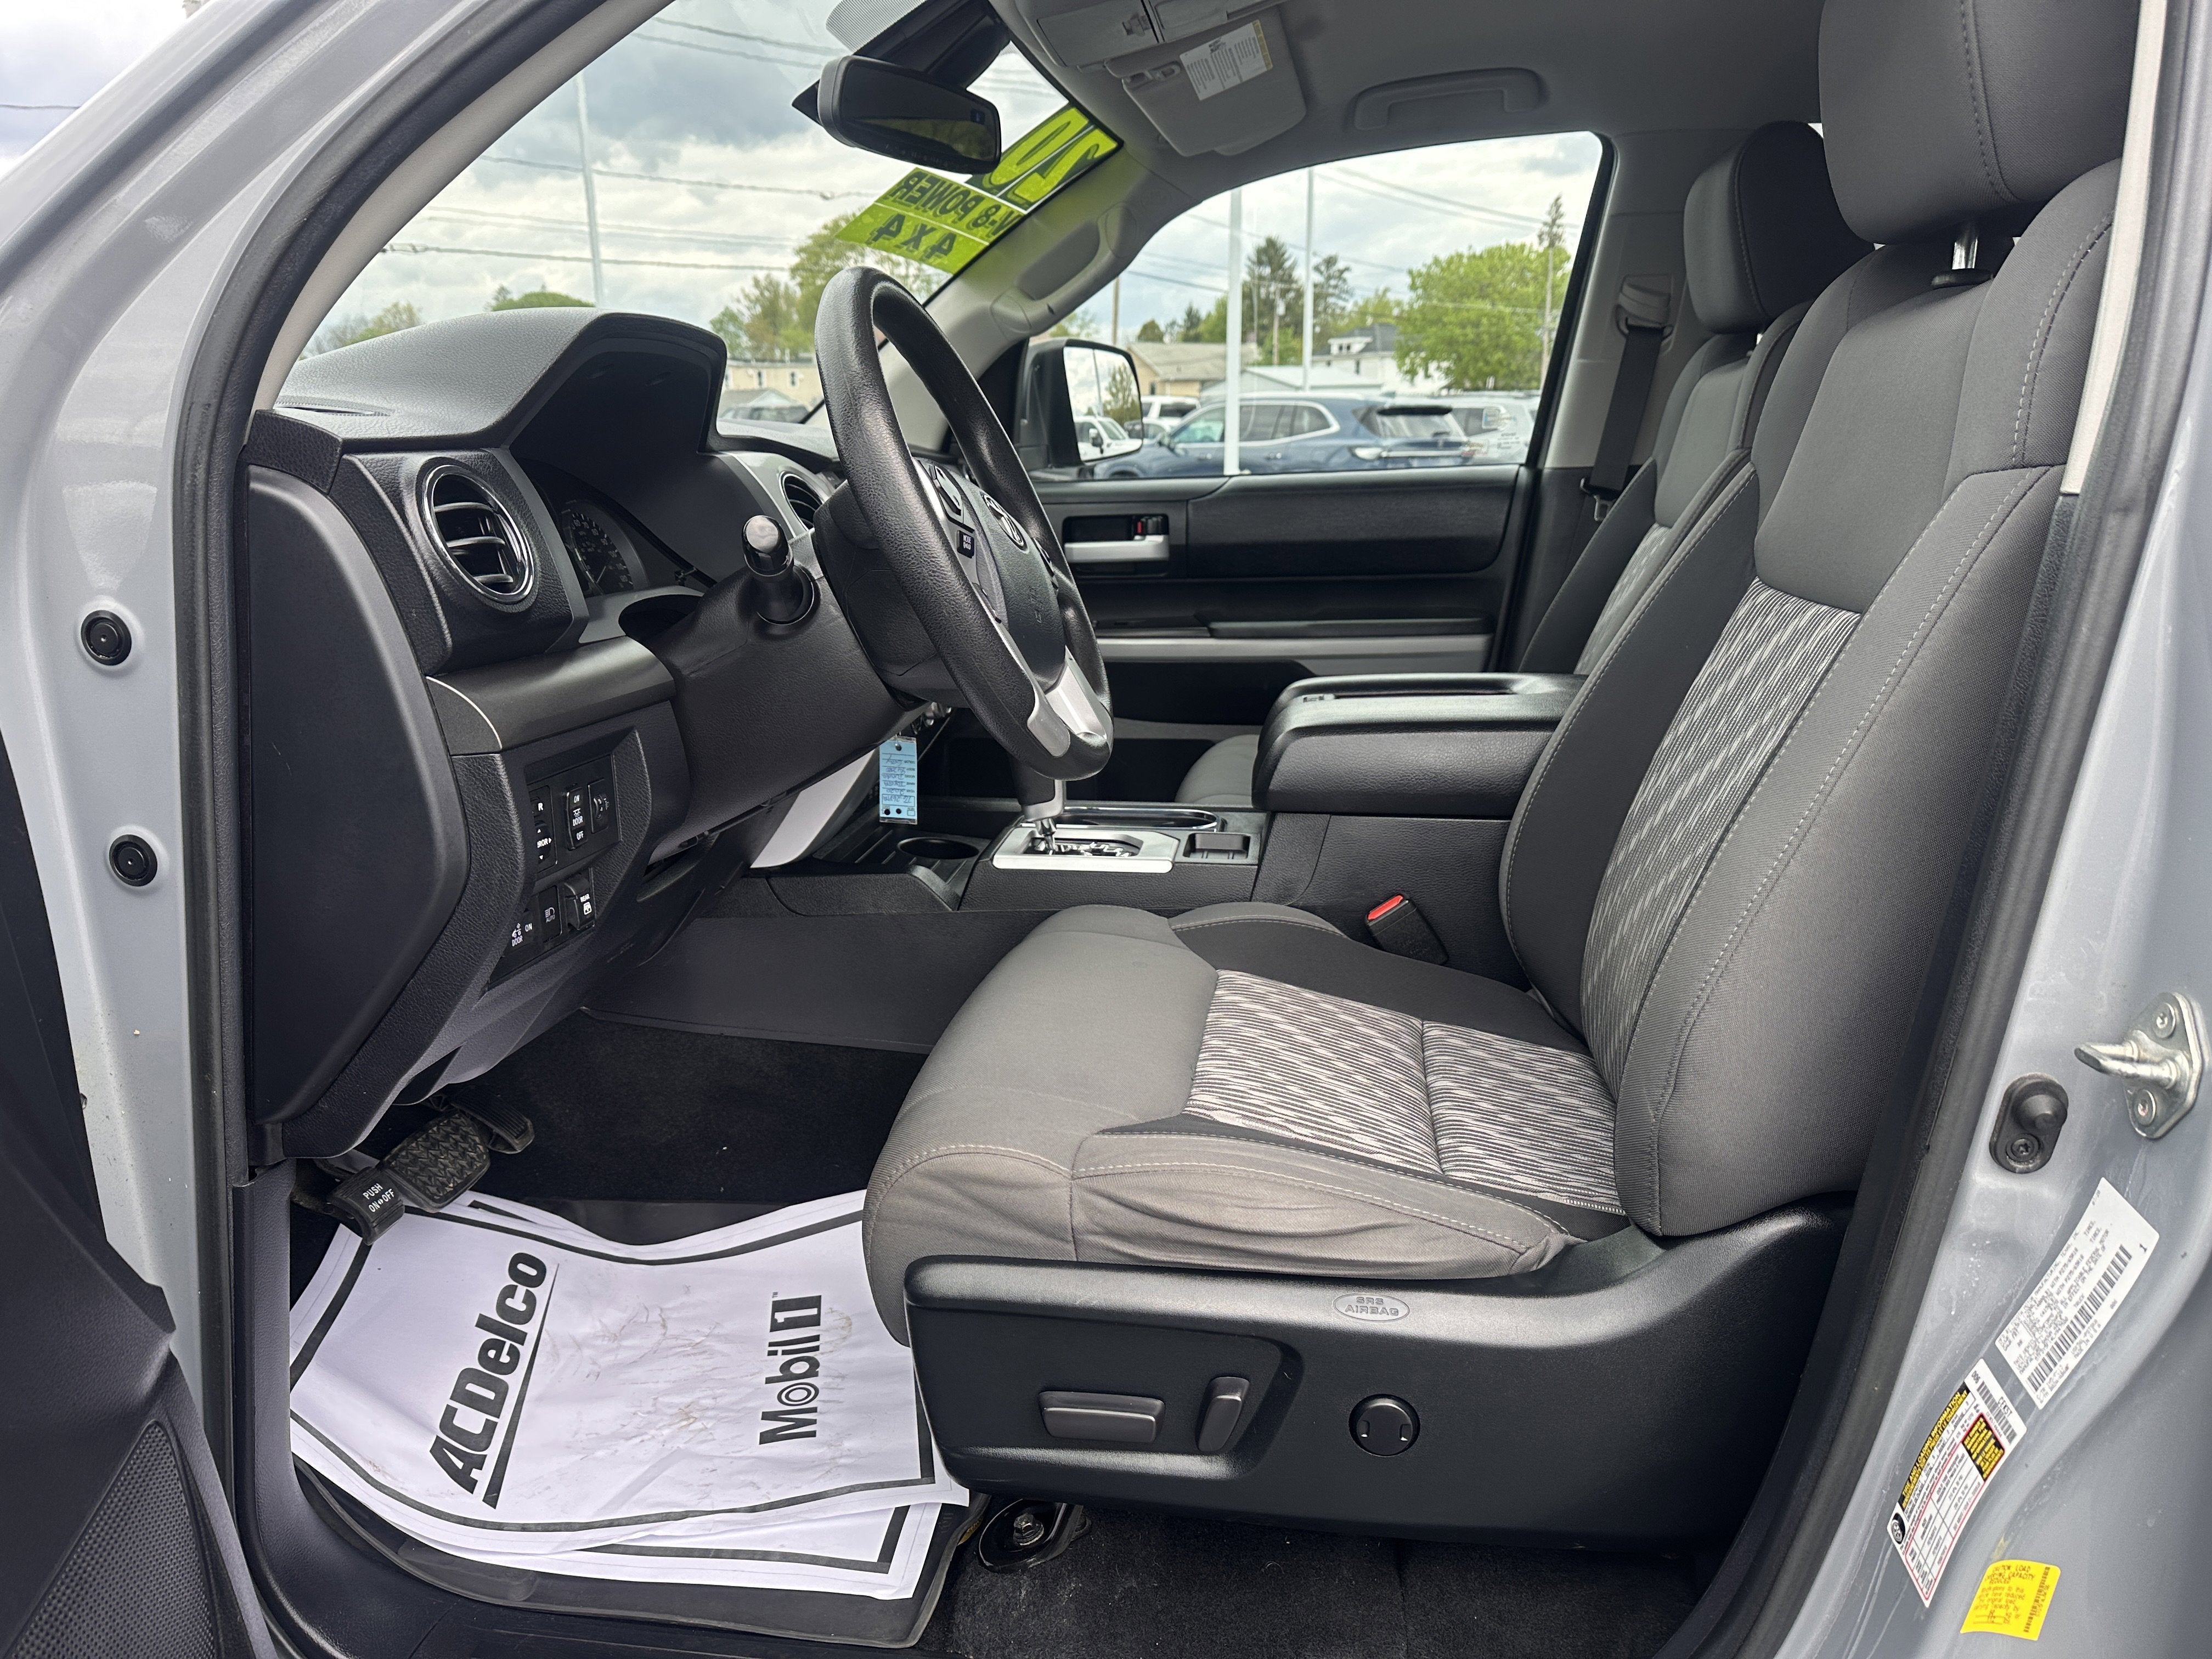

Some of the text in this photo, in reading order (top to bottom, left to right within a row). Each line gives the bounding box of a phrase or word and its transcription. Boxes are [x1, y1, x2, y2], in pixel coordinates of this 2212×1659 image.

[574, 795, 580, 803] ON
[538, 803, 544, 811] R
[572, 816, 583, 826] DOOR
[580, 894, 590, 902] REAR
[546, 914, 556, 923] AUTO
[525, 923, 533, 932] ON
[512, 935, 523, 947] DOOR
[363, 1183, 383, 1200] PUSH
[1356, 1296, 1384, 1305] SRS
[1345, 1305, 1399, 1316] AIRBAG
[429, 1252, 547, 1495] ACDelco
[759, 1334, 821, 1445] Mobil
[1915, 1435, 1932, 1468] LOADING
[1931, 1391, 1960, 1437] INFORMATION
